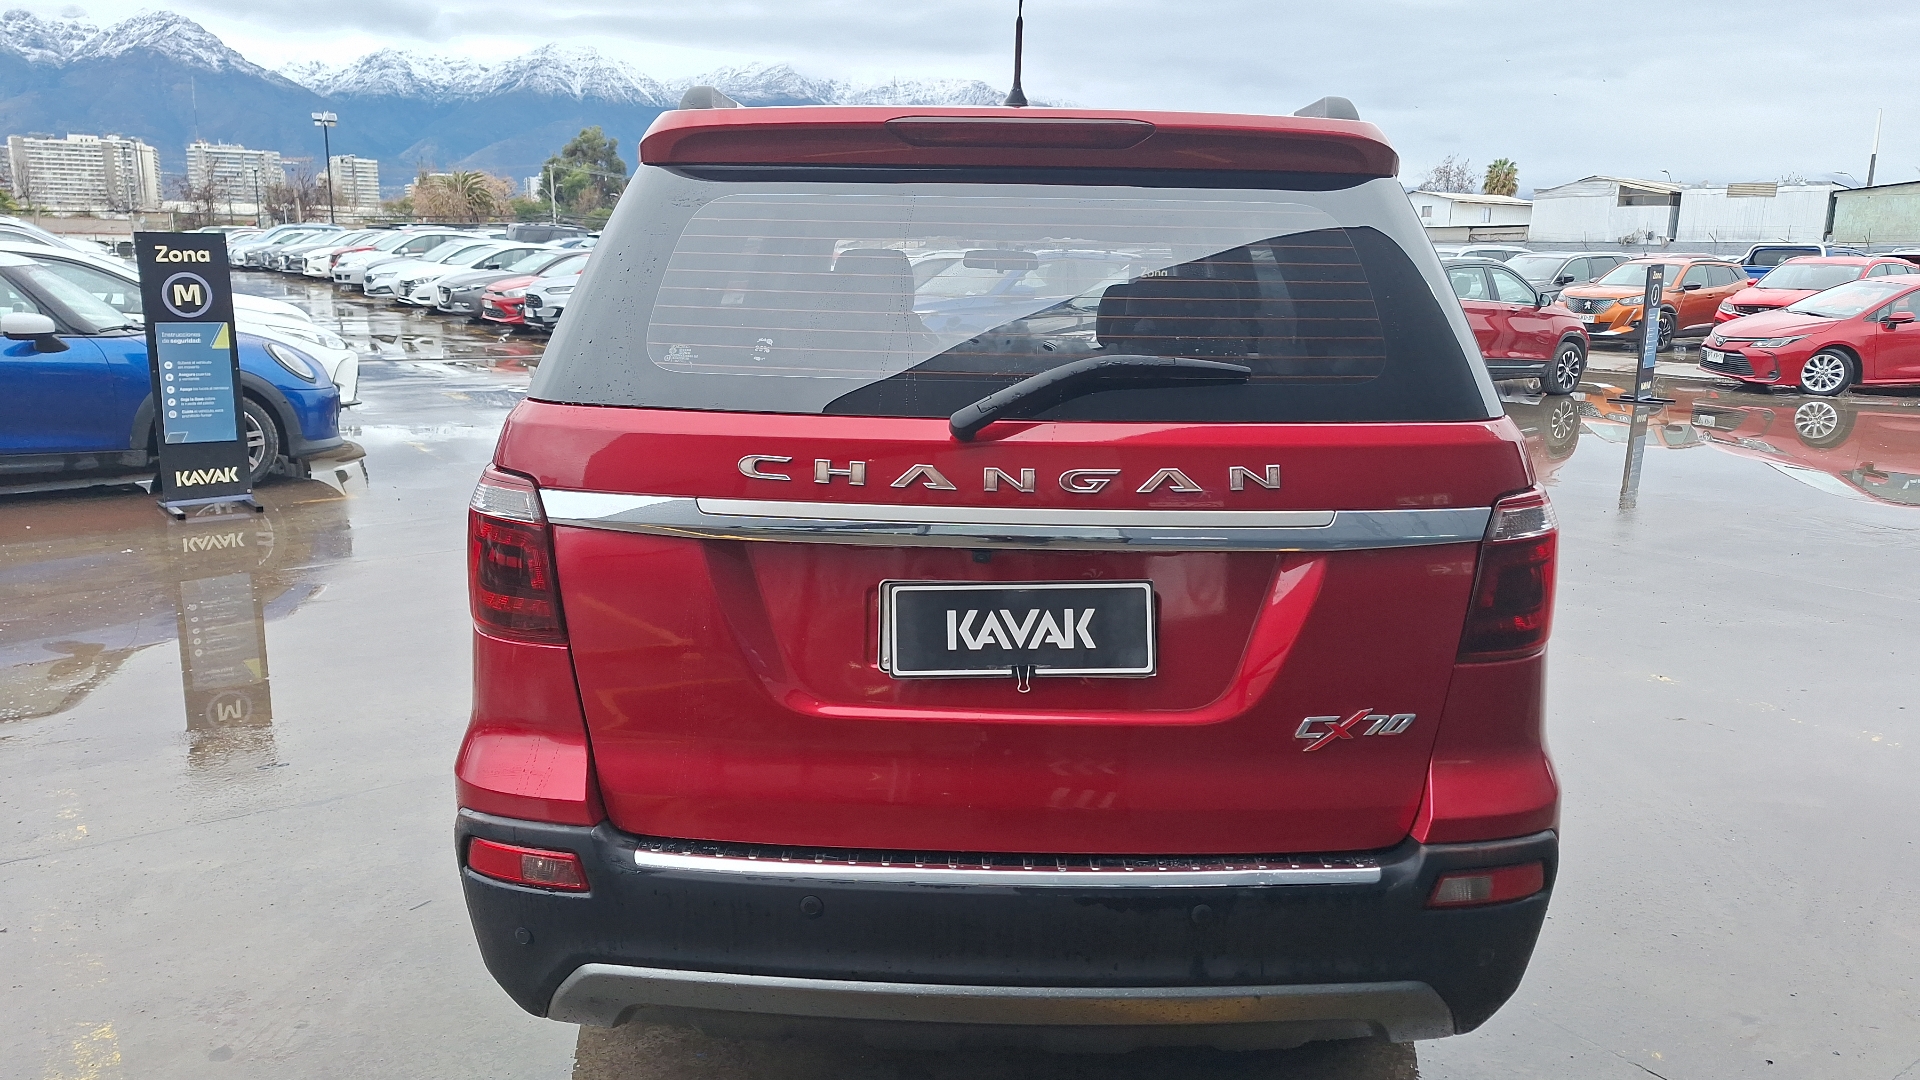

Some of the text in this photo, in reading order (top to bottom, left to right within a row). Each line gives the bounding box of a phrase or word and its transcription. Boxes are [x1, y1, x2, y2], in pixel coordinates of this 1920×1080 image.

[154, 245, 210, 263] Zona
[1140, 266, 1168, 278] Zona
[173, 284, 202, 306] M
[175, 466, 240, 487] KAVAK
[736, 452, 1283, 494] CHANGAN
[946, 607, 1097, 651] KAVAK
[1294, 707, 1417, 752] CX70
